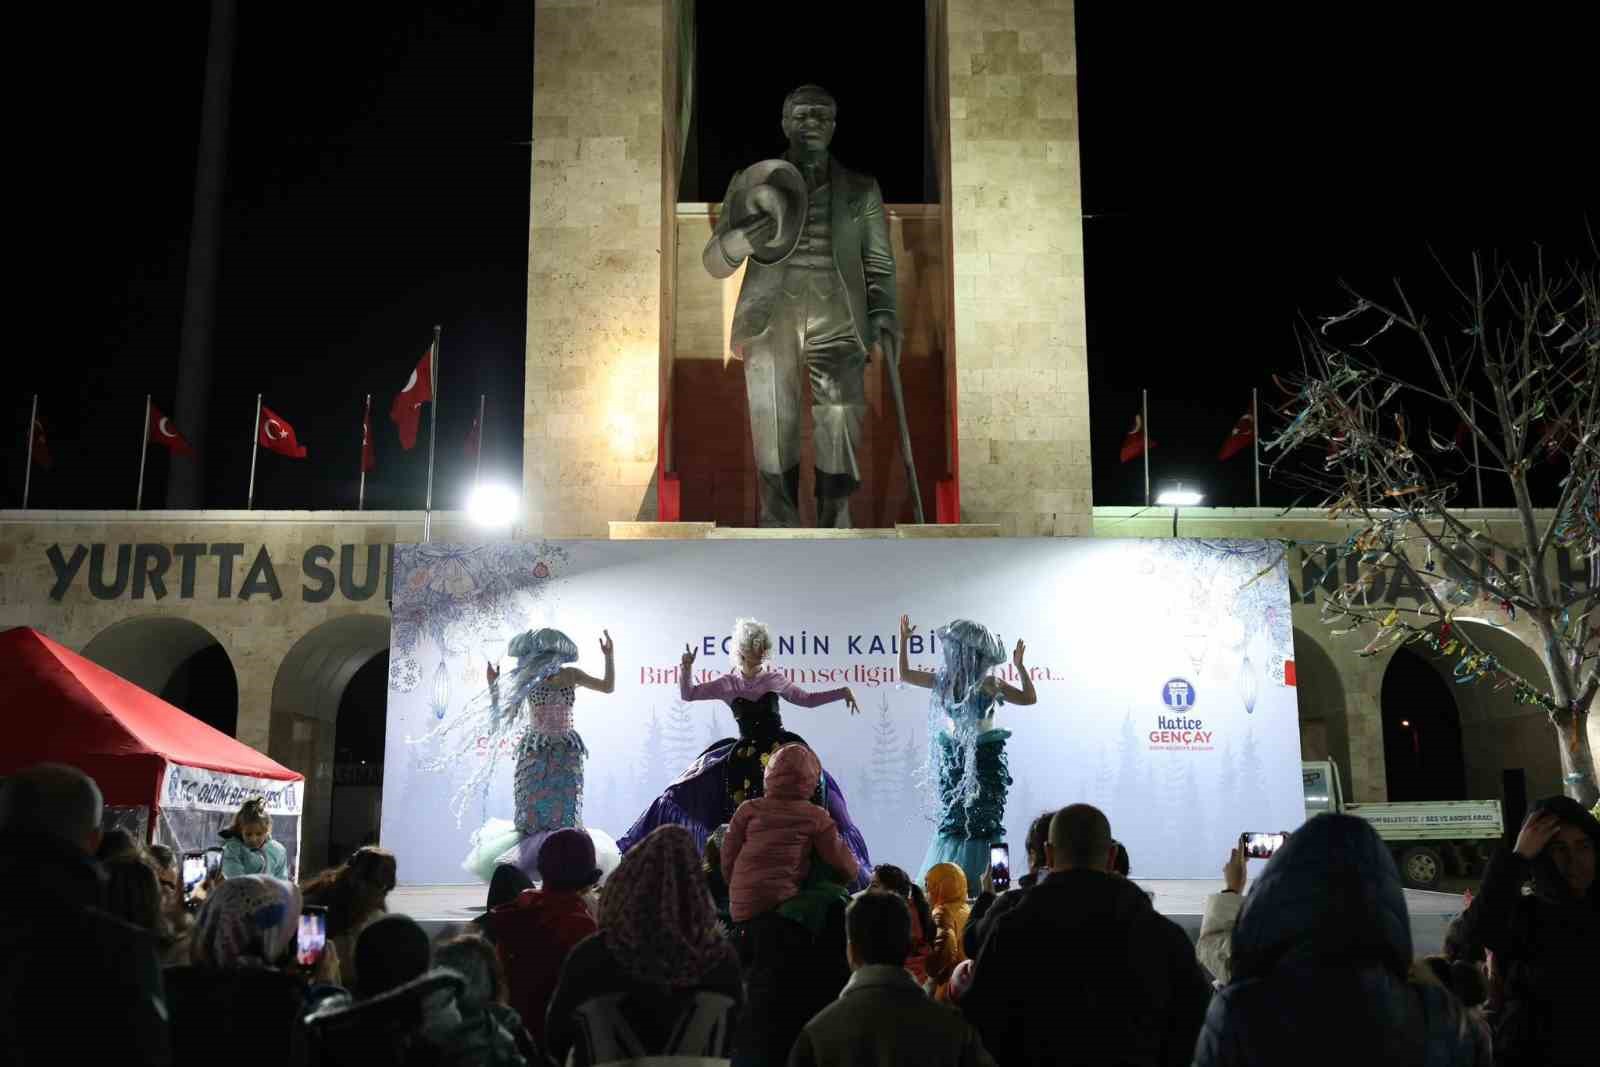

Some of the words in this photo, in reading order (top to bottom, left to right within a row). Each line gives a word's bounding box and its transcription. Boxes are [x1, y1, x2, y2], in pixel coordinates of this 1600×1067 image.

[46, 543, 283, 603] YURTTA
[1289, 543, 1432, 606] NDA
[703, 630, 830, 656] EGNİN
[1158, 716, 1202, 730] Hatice
[1149, 731, 1212, 745] GENÇAY
